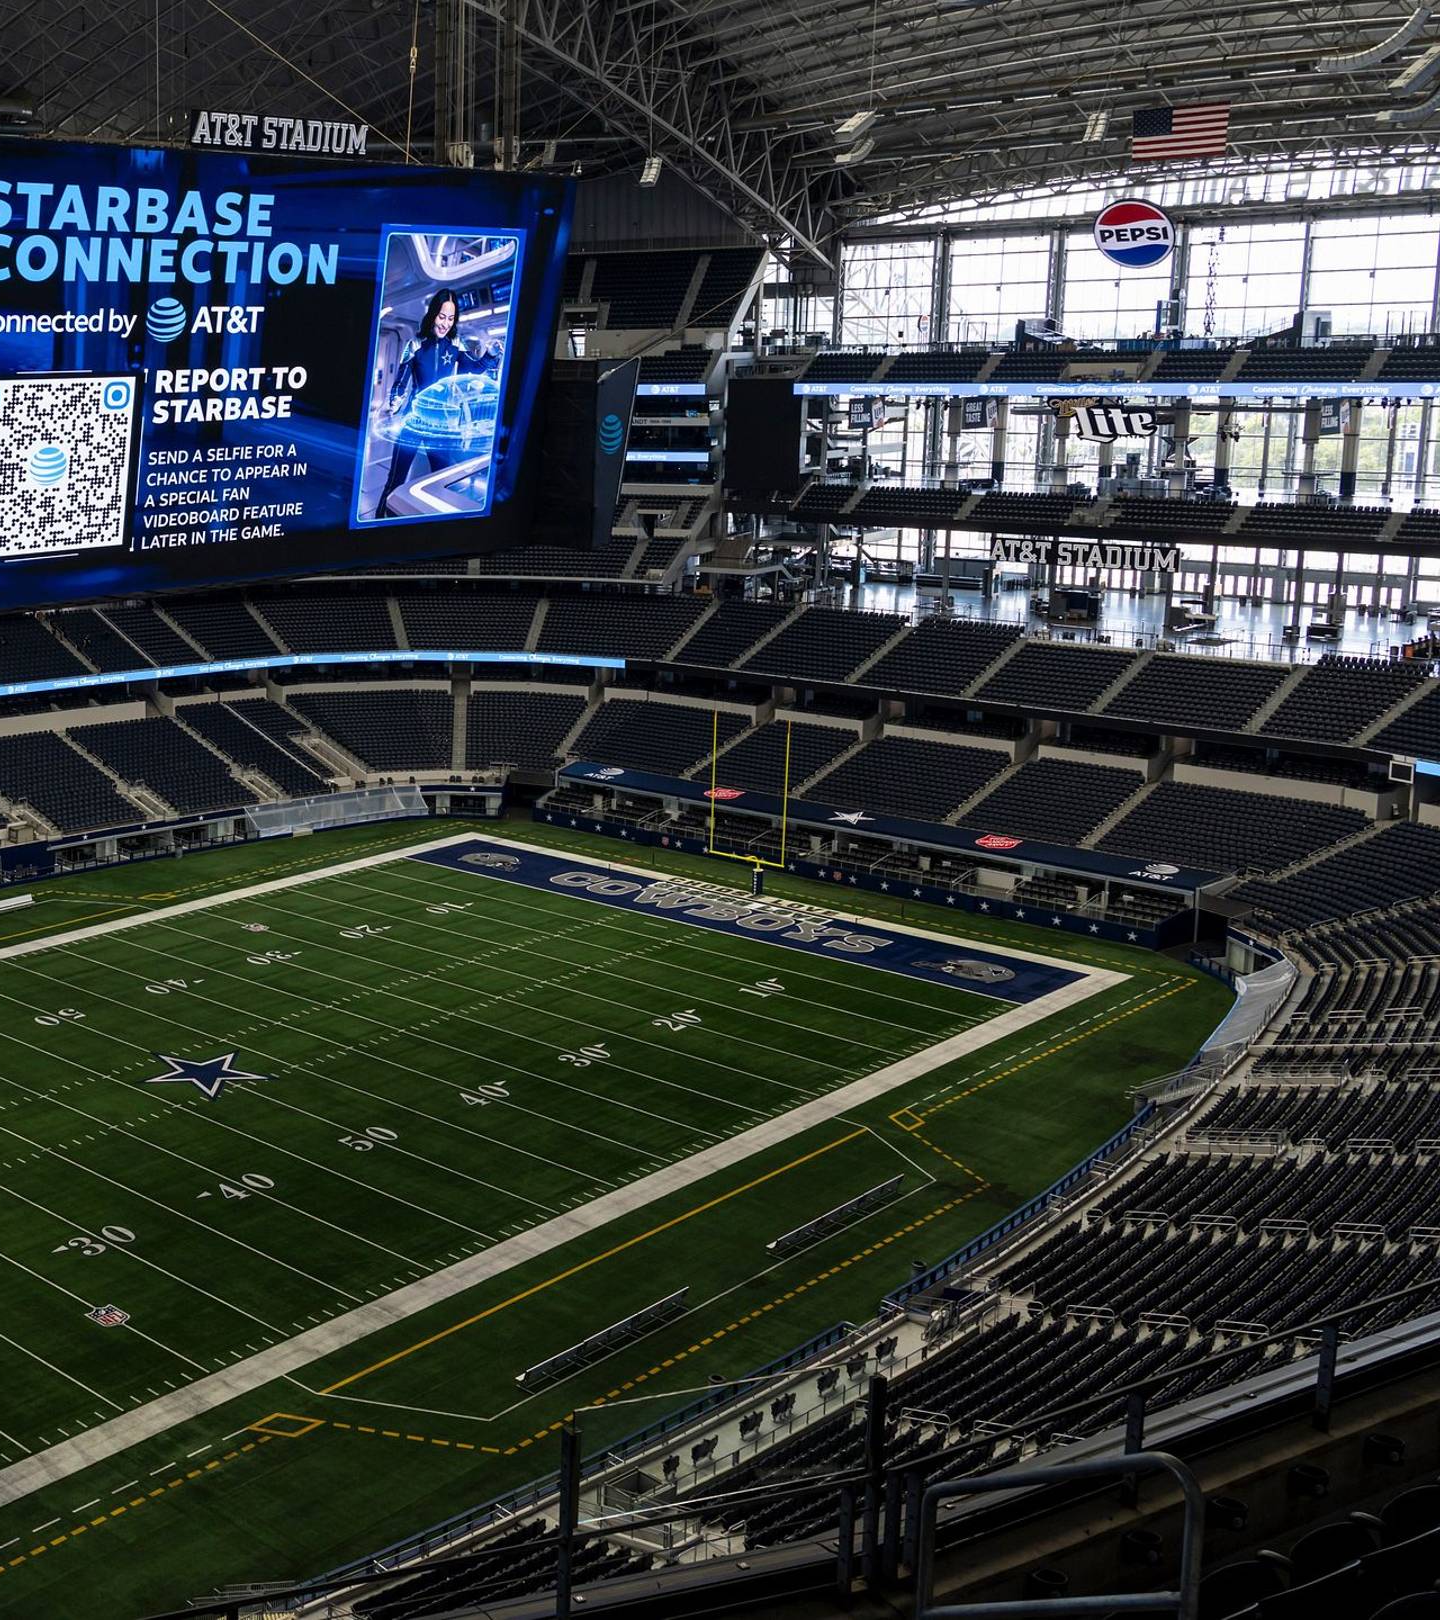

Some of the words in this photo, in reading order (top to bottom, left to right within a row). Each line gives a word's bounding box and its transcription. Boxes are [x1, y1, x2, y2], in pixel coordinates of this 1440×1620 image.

[192, 111, 258, 147] AT&T
[262, 116, 368, 155] STADIUM
[1099, 227, 1169, 243] PEPSI
[108, 309, 137, 338] by
[191, 306, 264, 334] AT&T
[155, 367, 266, 394] REPORT
[272, 366, 307, 390] TO
[850, 386, 883, 394] Connecting
[915, 385, 950, 394] Everything
[1036, 386, 1075, 394] Connecting
[1112, 385, 1152, 394] Everything
[1253, 386, 1297, 395] Connecting
[1342, 386, 1388, 395] Everything
[152, 396, 292, 424] STARBASE
[1073, 406, 1158, 442] Lite
[148, 450, 188, 465] SEND
[192, 449, 203, 462] A
[207, 446, 253, 462] SELFIE
[256, 445, 284, 459] FOR
[287, 444, 297, 456] A
[146, 470, 208, 487] CHANCE
[212, 468, 231, 481] TO
[235, 464, 289, 480] APPEAR
[293, 463, 307, 476] IN
[144, 494, 155, 508] A
[160, 490, 218, 507] SPECIAL
[222, 487, 250, 501] FAN
[143, 508, 239, 528] VIDEOBOARD
[243, 502, 303, 520] FEATURE
[141, 534, 187, 550] LATER
[191, 531, 206, 544] IN
[210, 528, 238, 543] THE
[241, 524, 285, 540] GAME.
[990, 539, 1051, 564] AT&T
[1057, 543, 1177, 572] STADIUM
[425, 901, 469, 915] 10
[550, 871, 894, 953] COWBOYS
[338, 923, 377, 939] 20
[246, 950, 293, 965] 30
[144, 978, 189, 996] 40
[740, 978, 786, 999] 10
[34, 1007, 87, 1027] 50
[652, 1009, 702, 1032] 20
[558, 1043, 611, 1069] 30
[460, 1082, 511, 1108] 40
[338, 1126, 399, 1153] 50
[218, 1172, 276, 1200] 40
[68, 1224, 136, 1257] 30
